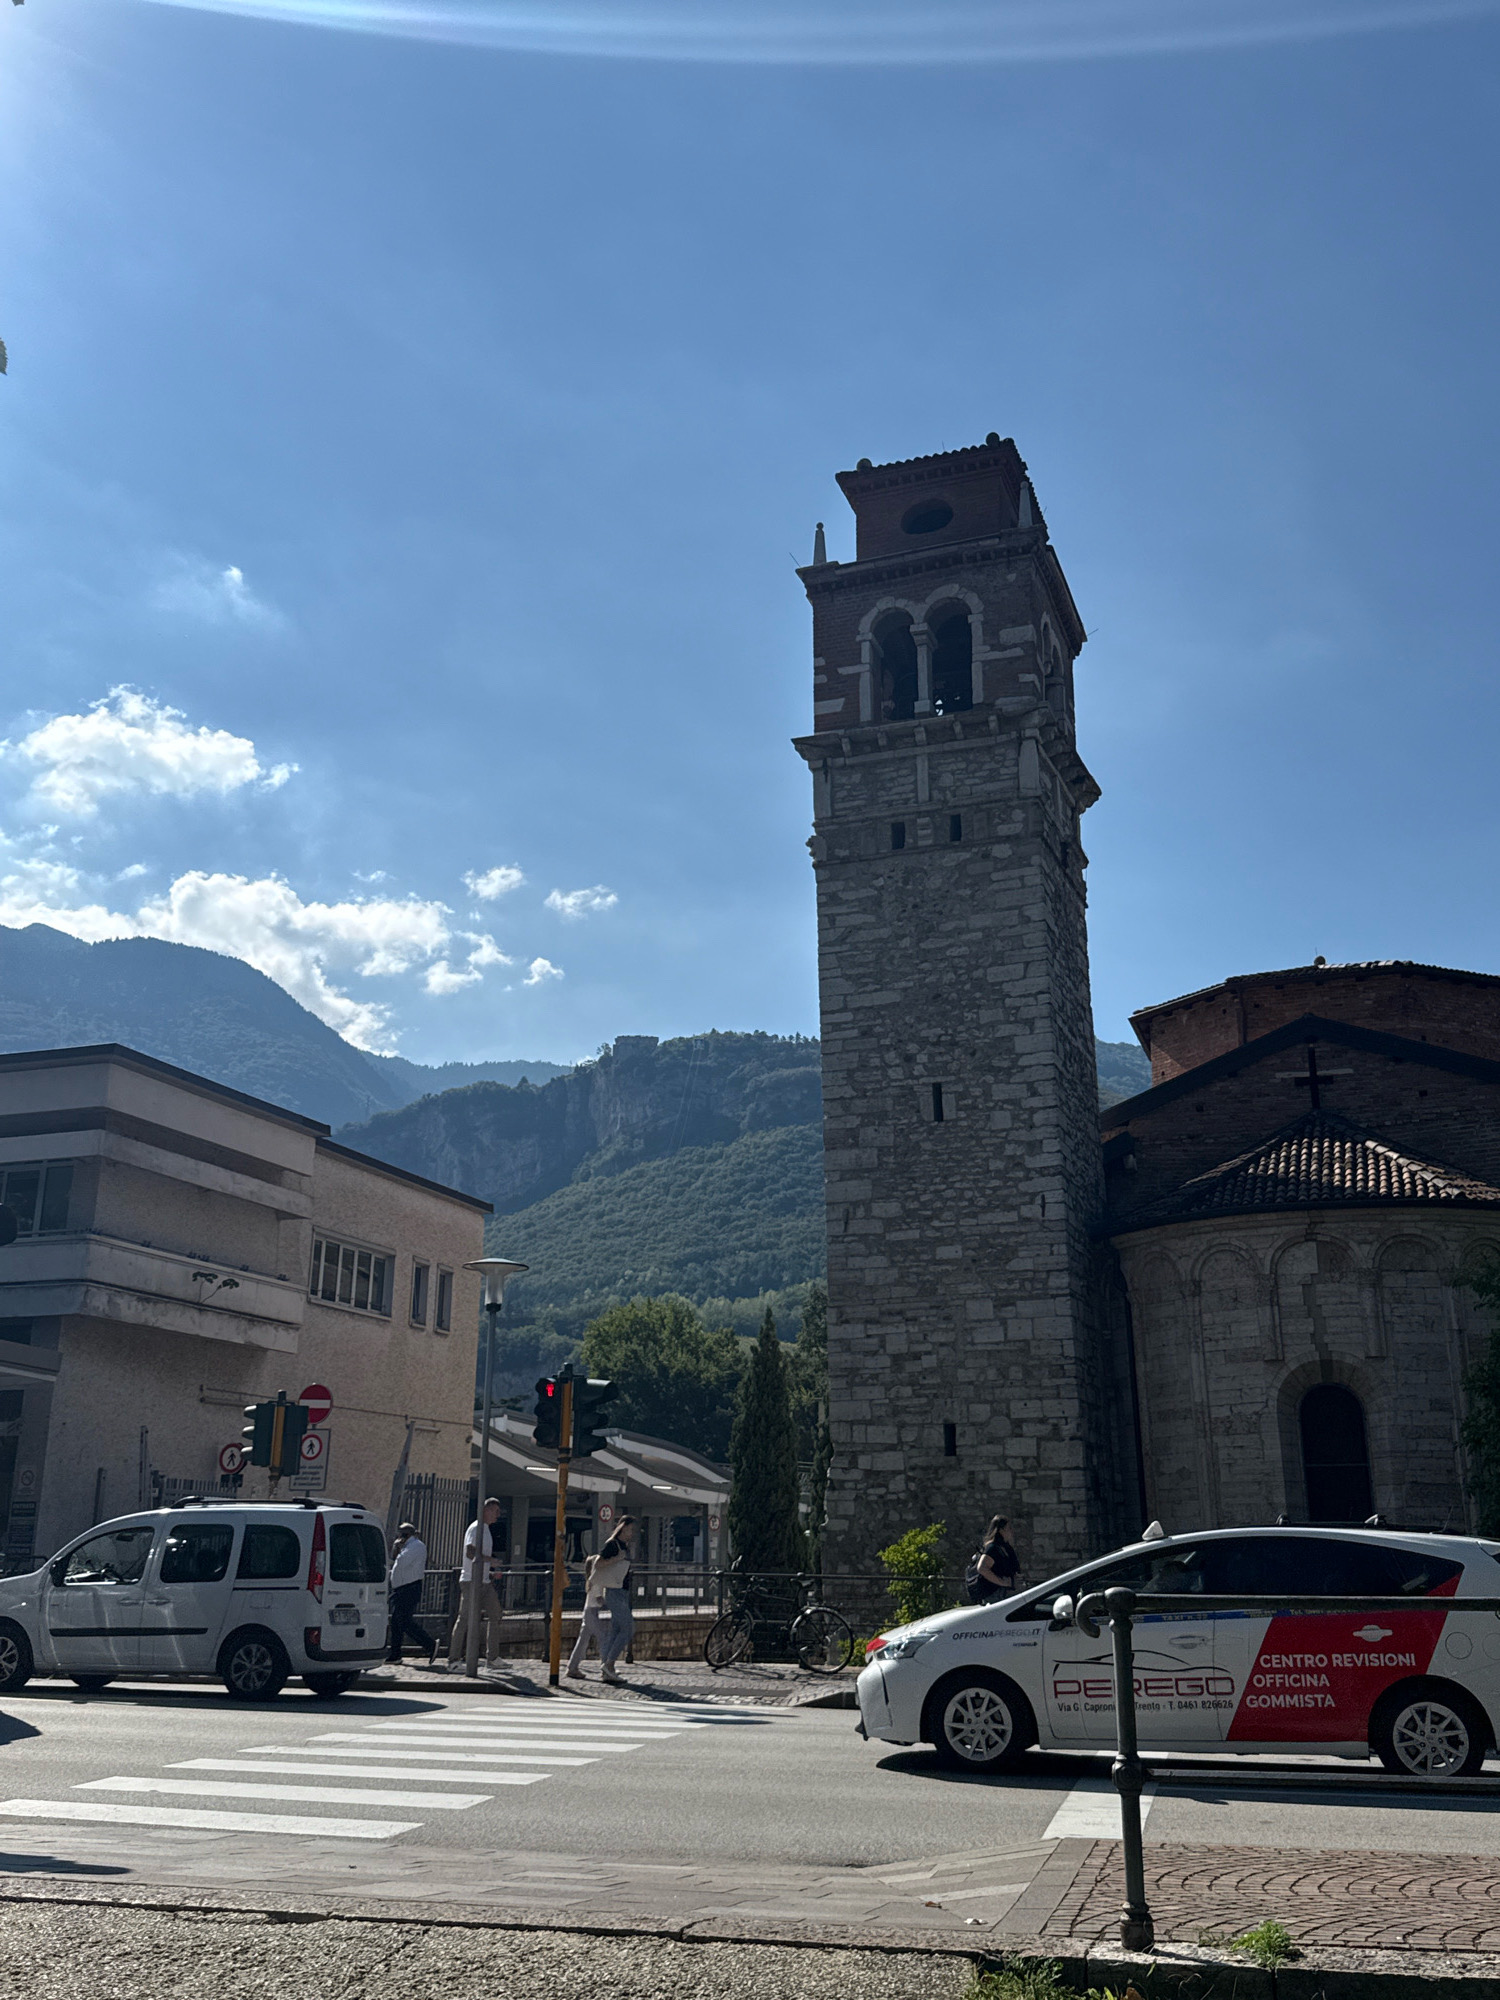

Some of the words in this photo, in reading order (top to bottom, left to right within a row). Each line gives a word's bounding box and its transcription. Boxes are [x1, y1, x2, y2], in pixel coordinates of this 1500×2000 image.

[1259, 1654, 1328, 1668] CENTRO
[1331, 1653, 1417, 1667] REVISIONI
[1252, 1673, 1330, 1688] OFFICINA
[1057, 1702, 1072, 1712] Via
[1177, 1700, 1198, 1710] 0461
[1201, 1699, 1234, 1710] 826626
[1245, 1694, 1336, 1708] GOMMISTA
